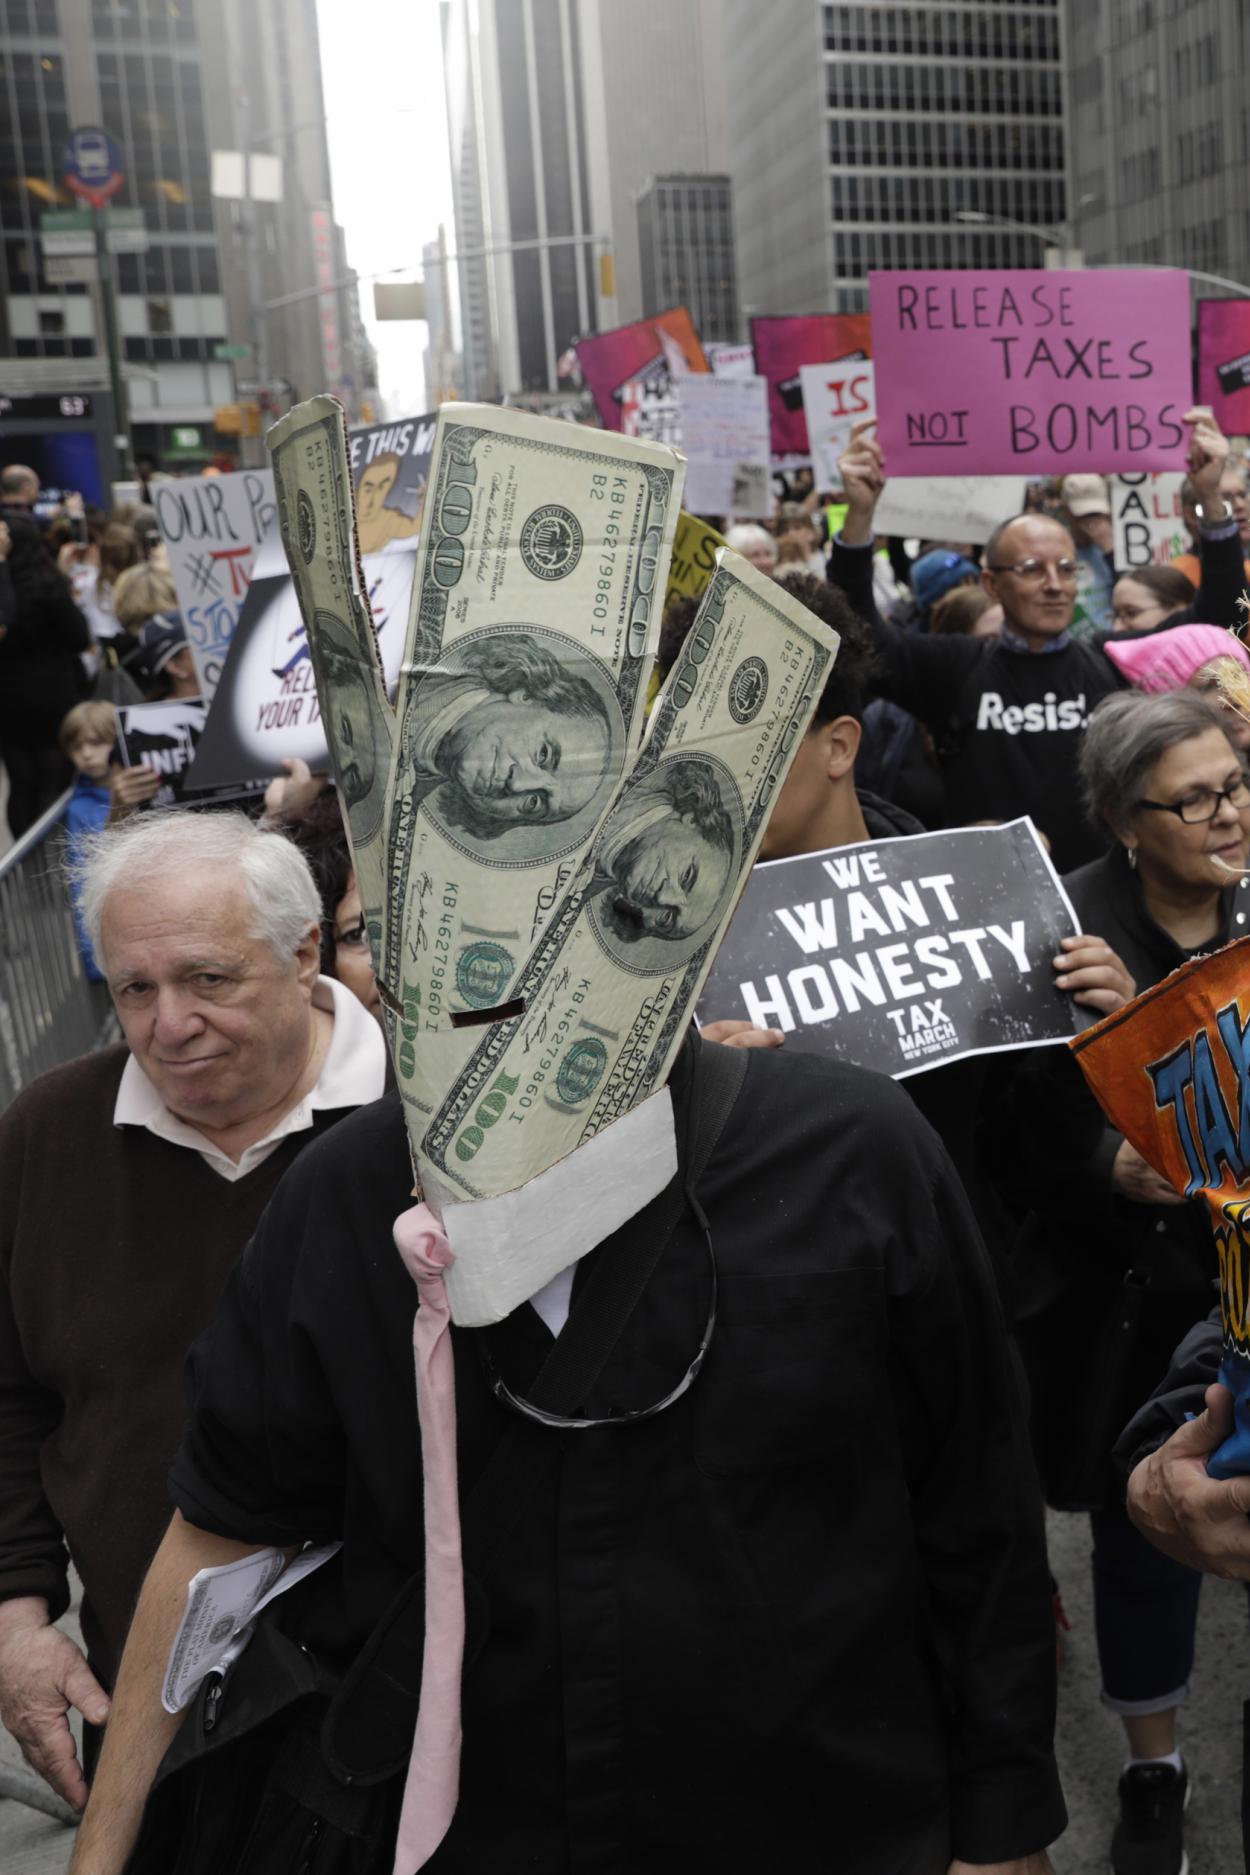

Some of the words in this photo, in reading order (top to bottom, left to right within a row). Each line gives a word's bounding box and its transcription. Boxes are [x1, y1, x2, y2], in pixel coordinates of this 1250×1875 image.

[898, 285, 1074, 330] RELEASE
[991, 337, 1153, 379] TAXES
[827, 375, 869, 416] IS
[365, 424, 414, 464] THIS
[907, 411, 968, 440] NOT
[1010, 403, 1183, 454] BOMBS
[590, 474, 607, 500] B2
[157, 483, 239, 542] OUR
[611, 628, 623, 668] NOTE
[256, 700, 302, 732] YOUR
[822, 852, 887, 889] WE
[775, 874, 960, 954] WANT
[739, 921, 1031, 1034] HONESTY
[399, 976, 422, 1079] 100
[886, 998, 951, 1036] TAX
[898, 1022, 956, 1052] MARCH
[942, 1037, 959, 1049] CITY
[455, 1066, 520, 1162] 100
